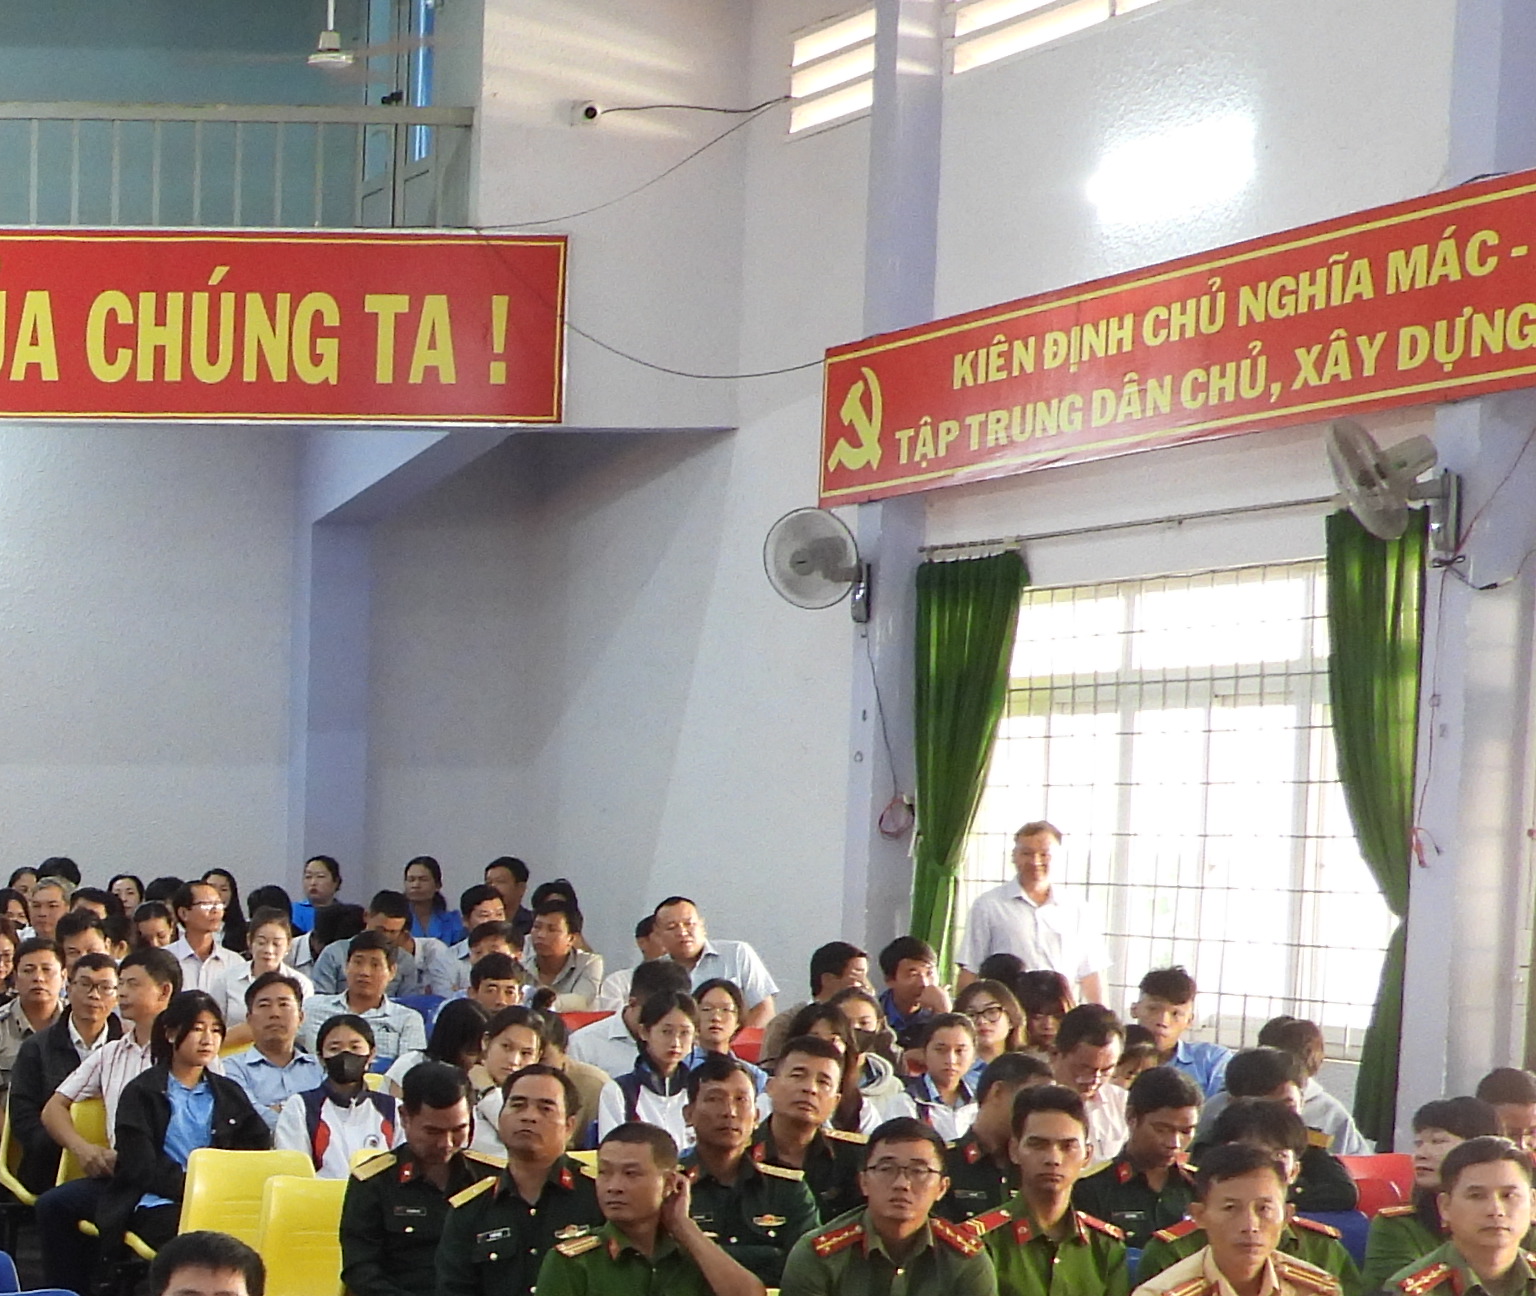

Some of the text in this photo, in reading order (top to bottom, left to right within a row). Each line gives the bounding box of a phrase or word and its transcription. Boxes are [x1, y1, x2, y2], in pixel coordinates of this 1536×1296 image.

[86, 266, 341, 385] CHÚNG
[365, 294, 457, 384] TA
[491, 295, 510, 379] !
[896, 302, 1536, 466] TẬP TRUNG DÂN CHỦ, XÂY DỰNG
[953, 333, 1038, 390] KIÊN
[1043, 312, 1136, 378] ĐỊNH
[1142, 277, 1227, 350] CHỦ
[1238, 251, 1375, 326] NGHĨA
[1386, 226, 1500, 295] MÁC
